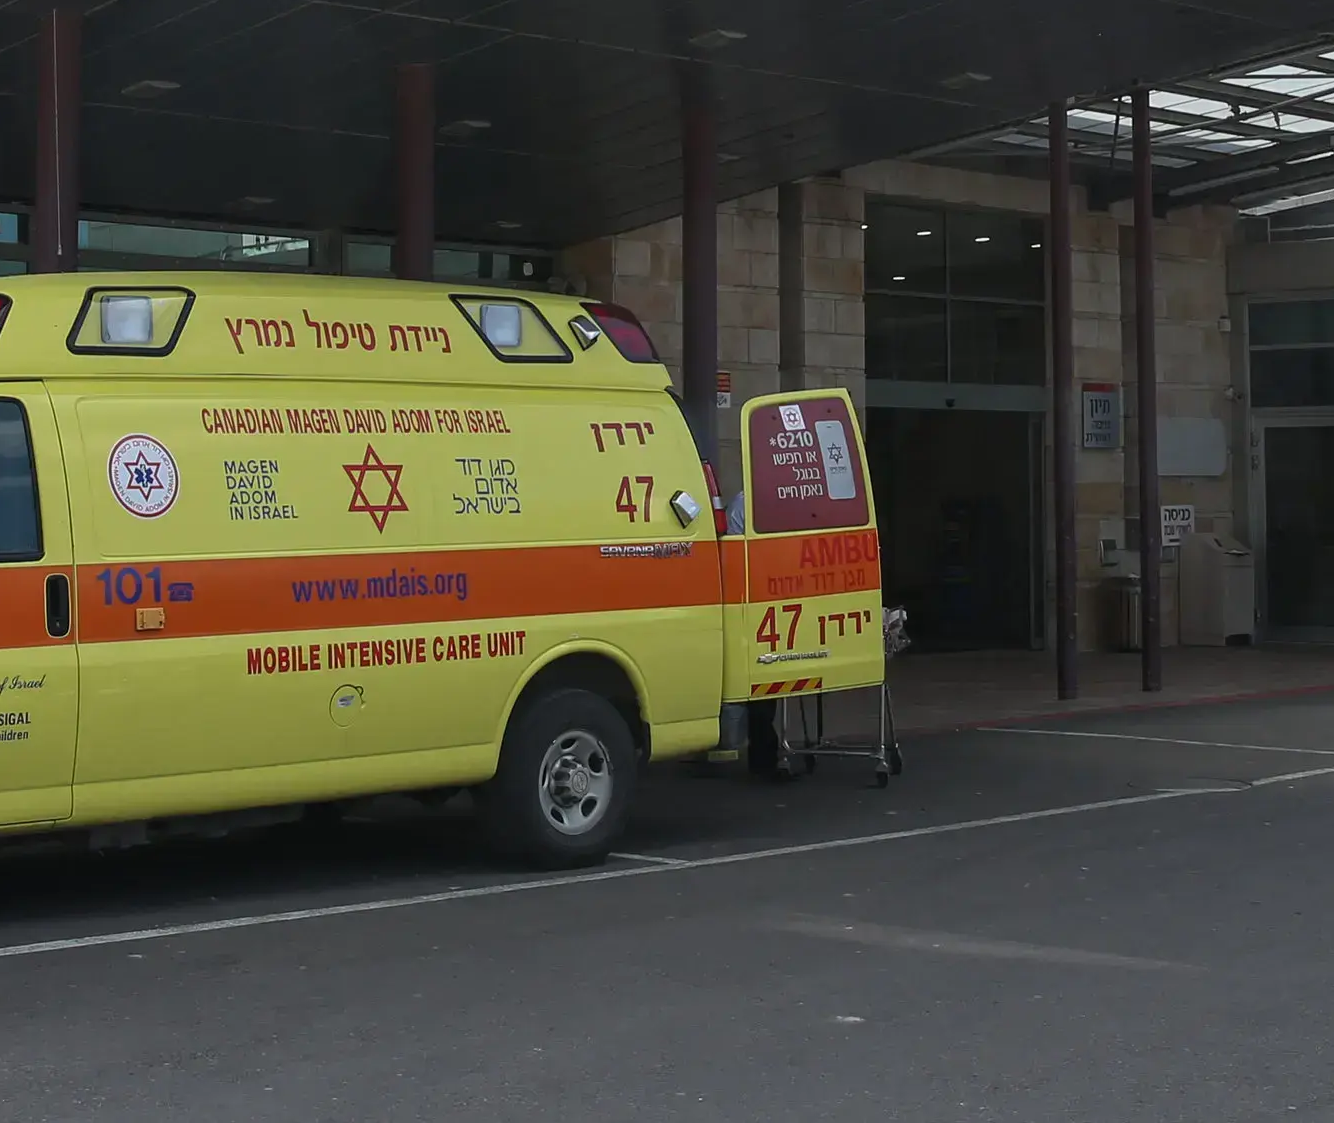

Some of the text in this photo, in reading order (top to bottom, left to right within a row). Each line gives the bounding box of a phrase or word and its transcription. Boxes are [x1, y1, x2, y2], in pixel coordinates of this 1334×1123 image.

[224, 309, 452, 355] ניידת טיפול נמרץ
[201, 407, 511, 434] CANADIAN MAGEN DAVID ADOM FOR ISRAEL
[590, 422, 655, 453] ירדן
[224, 460, 279, 474] MAGEN
[455, 459, 515, 478] מגן דוד
[772, 450, 818, 466] או חפשו
[226, 475, 273, 489] DAVID
[792, 466, 822, 481] בגוגל
[475, 478, 519, 494] אדום
[777, 484, 824, 500] נאמן חיים
[230, 490, 277, 504] ADOM
[453, 493, 521, 514] בישראל
[616, 476, 654, 523] 47
[230, 505, 299, 520] IN ISRAEL
[1163, 508, 1191, 522] כניסה
[96, 567, 163, 607] 101
[292, 567, 468, 604] www.mdais.org
[809, 571, 835, 592] דוד
[844, 568, 866, 593] מגן
[756, 603, 803, 652] 47
[817, 610, 872, 646] ירדן
[246, 630, 527, 675] MOBILE INTENSIVE CARE UNIT
[8, 674, 47, 690] Israel
